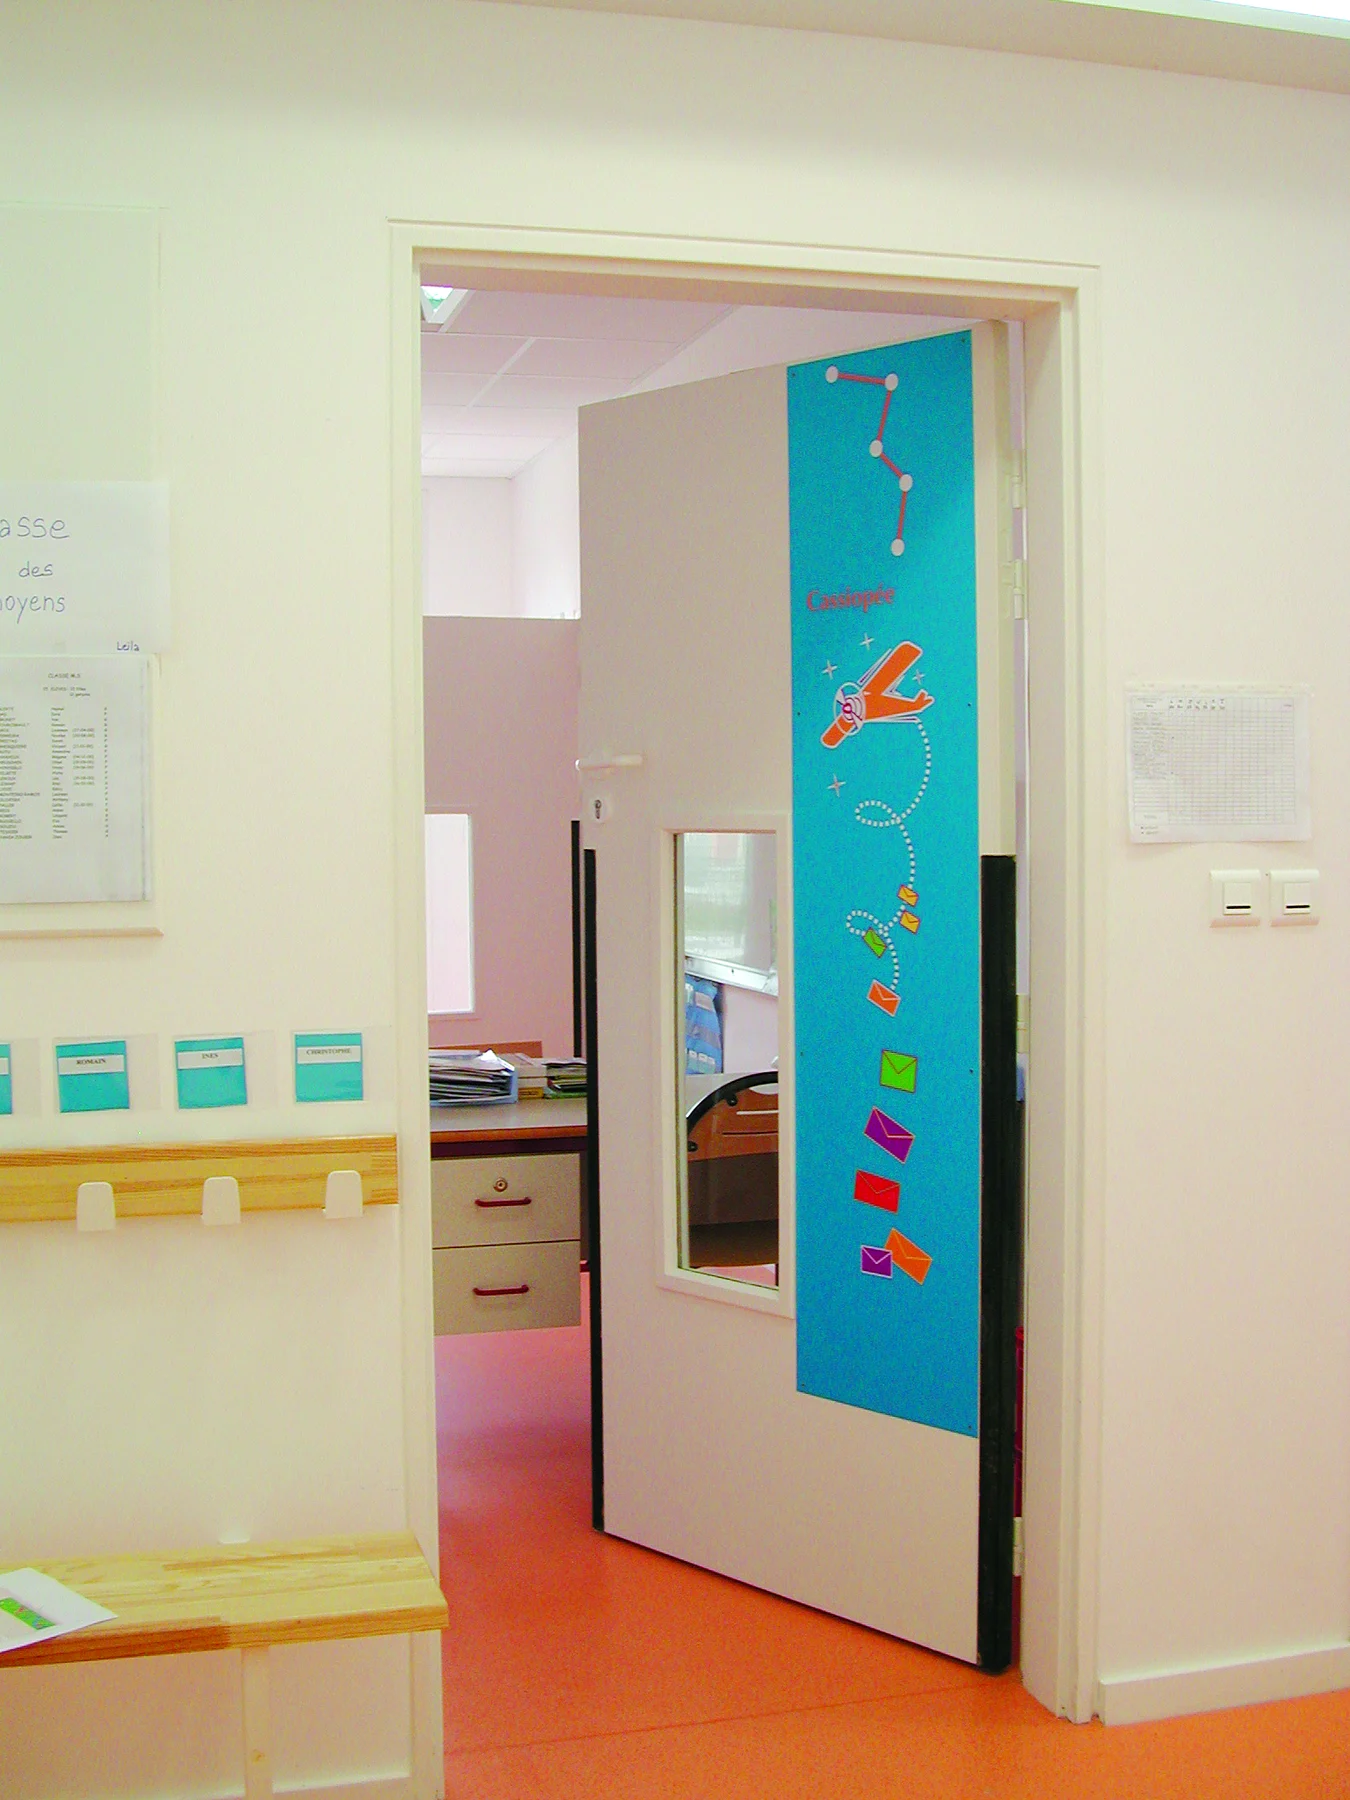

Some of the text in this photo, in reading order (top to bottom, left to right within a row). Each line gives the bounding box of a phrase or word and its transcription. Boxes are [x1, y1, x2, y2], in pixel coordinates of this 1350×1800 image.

[0, 516, 70, 539] asse
[18, 561, 53, 578] des
[805, 581, 895, 613] Cassiopée
[305, 1047, 352, 1056] CHRISTOPHE
[76, 1058, 107, 1066] ROMAIN
